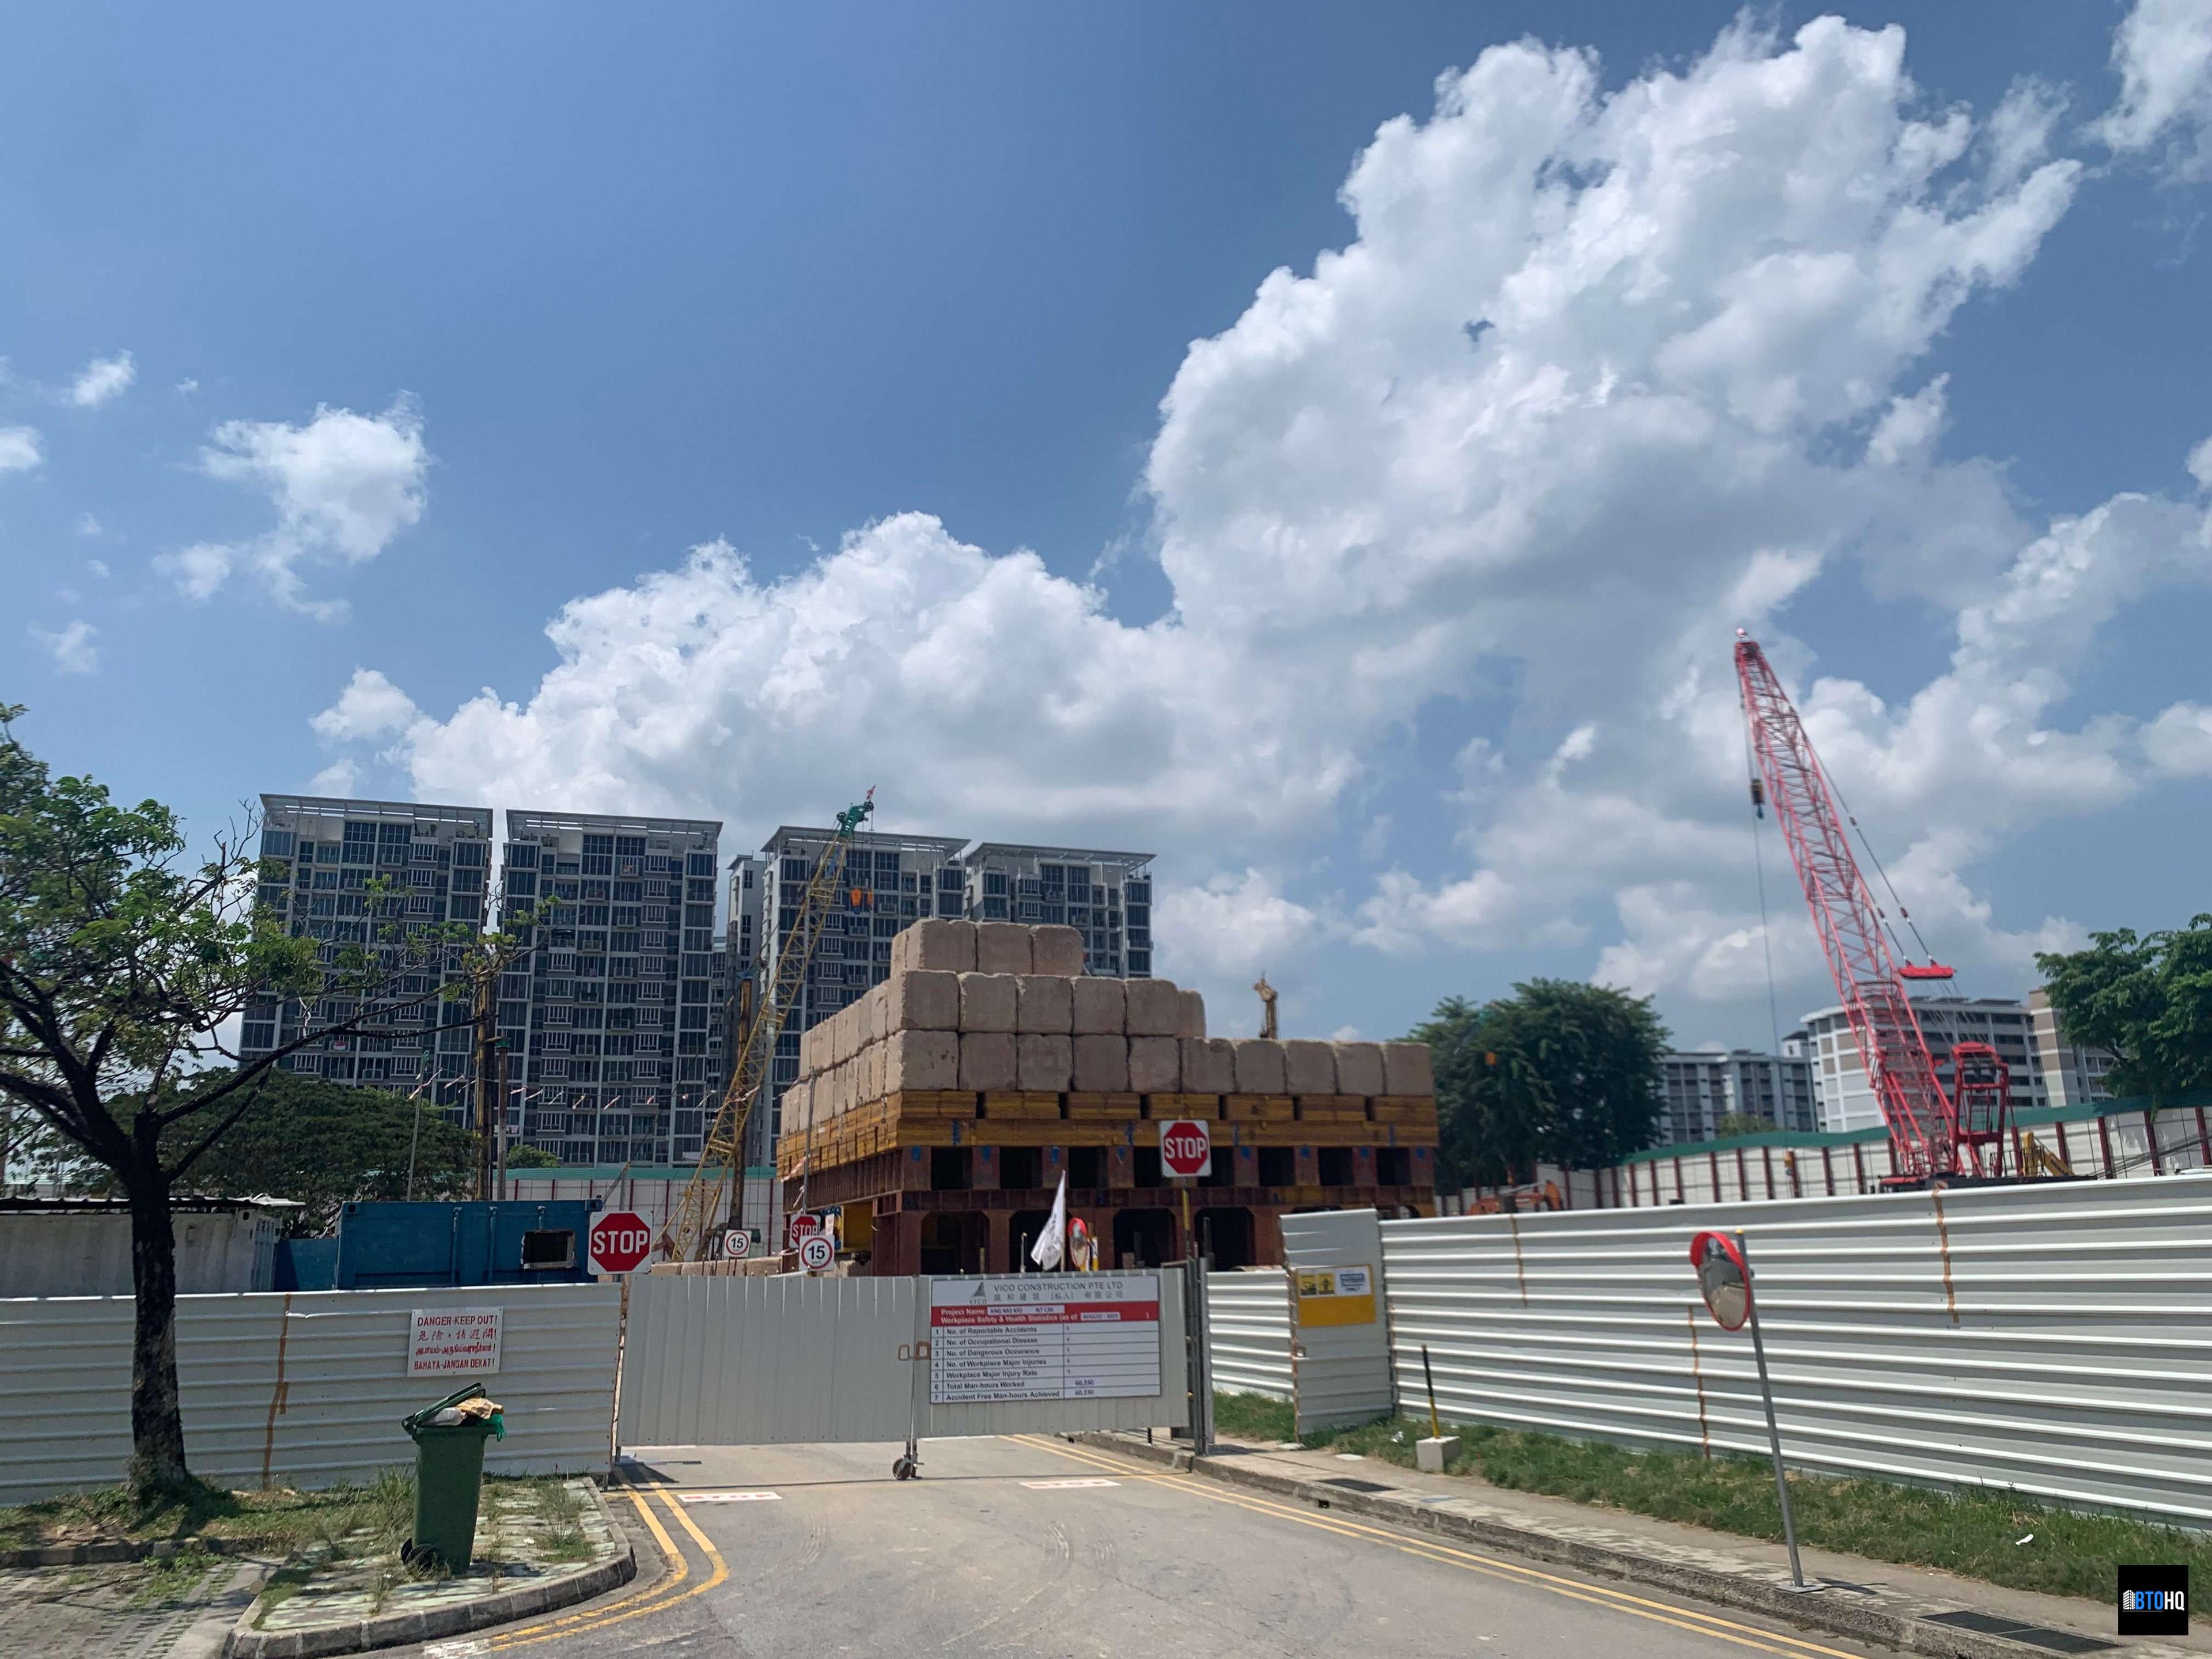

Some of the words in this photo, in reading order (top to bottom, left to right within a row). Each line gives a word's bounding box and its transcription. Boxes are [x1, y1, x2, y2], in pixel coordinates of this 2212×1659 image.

[1164, 1137, 1207, 1159] STOP
[593, 1230, 648, 1254] STOP
[731, 1237, 744, 1248] 15
[808, 1245, 825, 1259] 15
[994, 1284, 1015, 1292] VICO
[1017, 1282, 1086, 1291] CONSTRUCTION
[1088, 1282, 1104, 1290] PTE
[1107, 1281, 1123, 1289] LTD
[941, 1308, 964, 1317] Project
[940, 1317, 975, 1325] Workplace
[1028, 1313, 1058, 1321] Statistics
[968, 1327, 1003, 1336] Reportable
[967, 1338, 1011, 1347] Occupational
[967, 1349, 1003, 1357] Dangerous
[967, 1359, 1001, 1368] Workplace
[1003, 1359, 1021, 1367] Major
[1022, 1358, 1047, 1366] Injuries
[946, 1372, 980, 1380] Workplace
[982, 1371, 1001, 1379] Major
